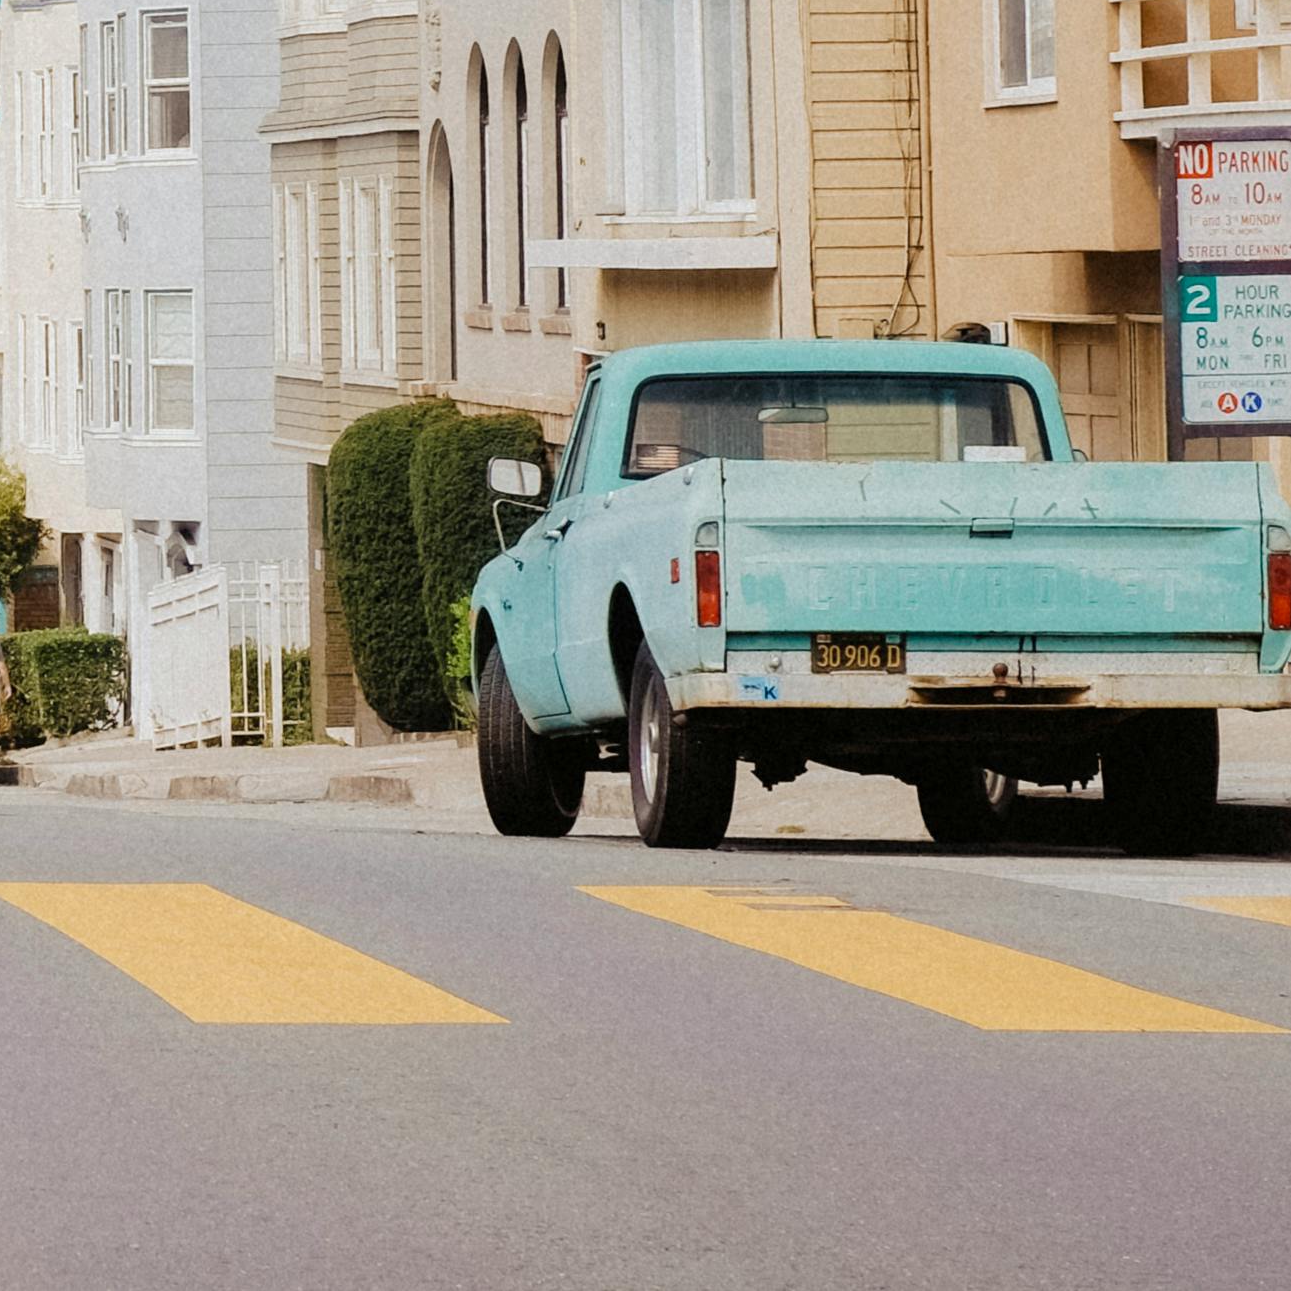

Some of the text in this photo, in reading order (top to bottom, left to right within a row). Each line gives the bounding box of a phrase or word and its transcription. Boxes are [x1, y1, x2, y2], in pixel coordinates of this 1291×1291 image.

[1179, 144, 1289, 175] NO PARKING
[1241, 212, 1281, 227] MONDAY
[1188, 243, 1288, 258] STREET CLEANING
[1186, 284, 1212, 315] 2
[1235, 285, 1280, 300] HOUR
[1224, 303, 1291, 320] PARKING
[1196, 355, 1229, 371] MON
[1264, 353, 1287, 369] FRI
[809, 566, 1181, 612] CHEVROLET
[763, 685, 777, 700] K
